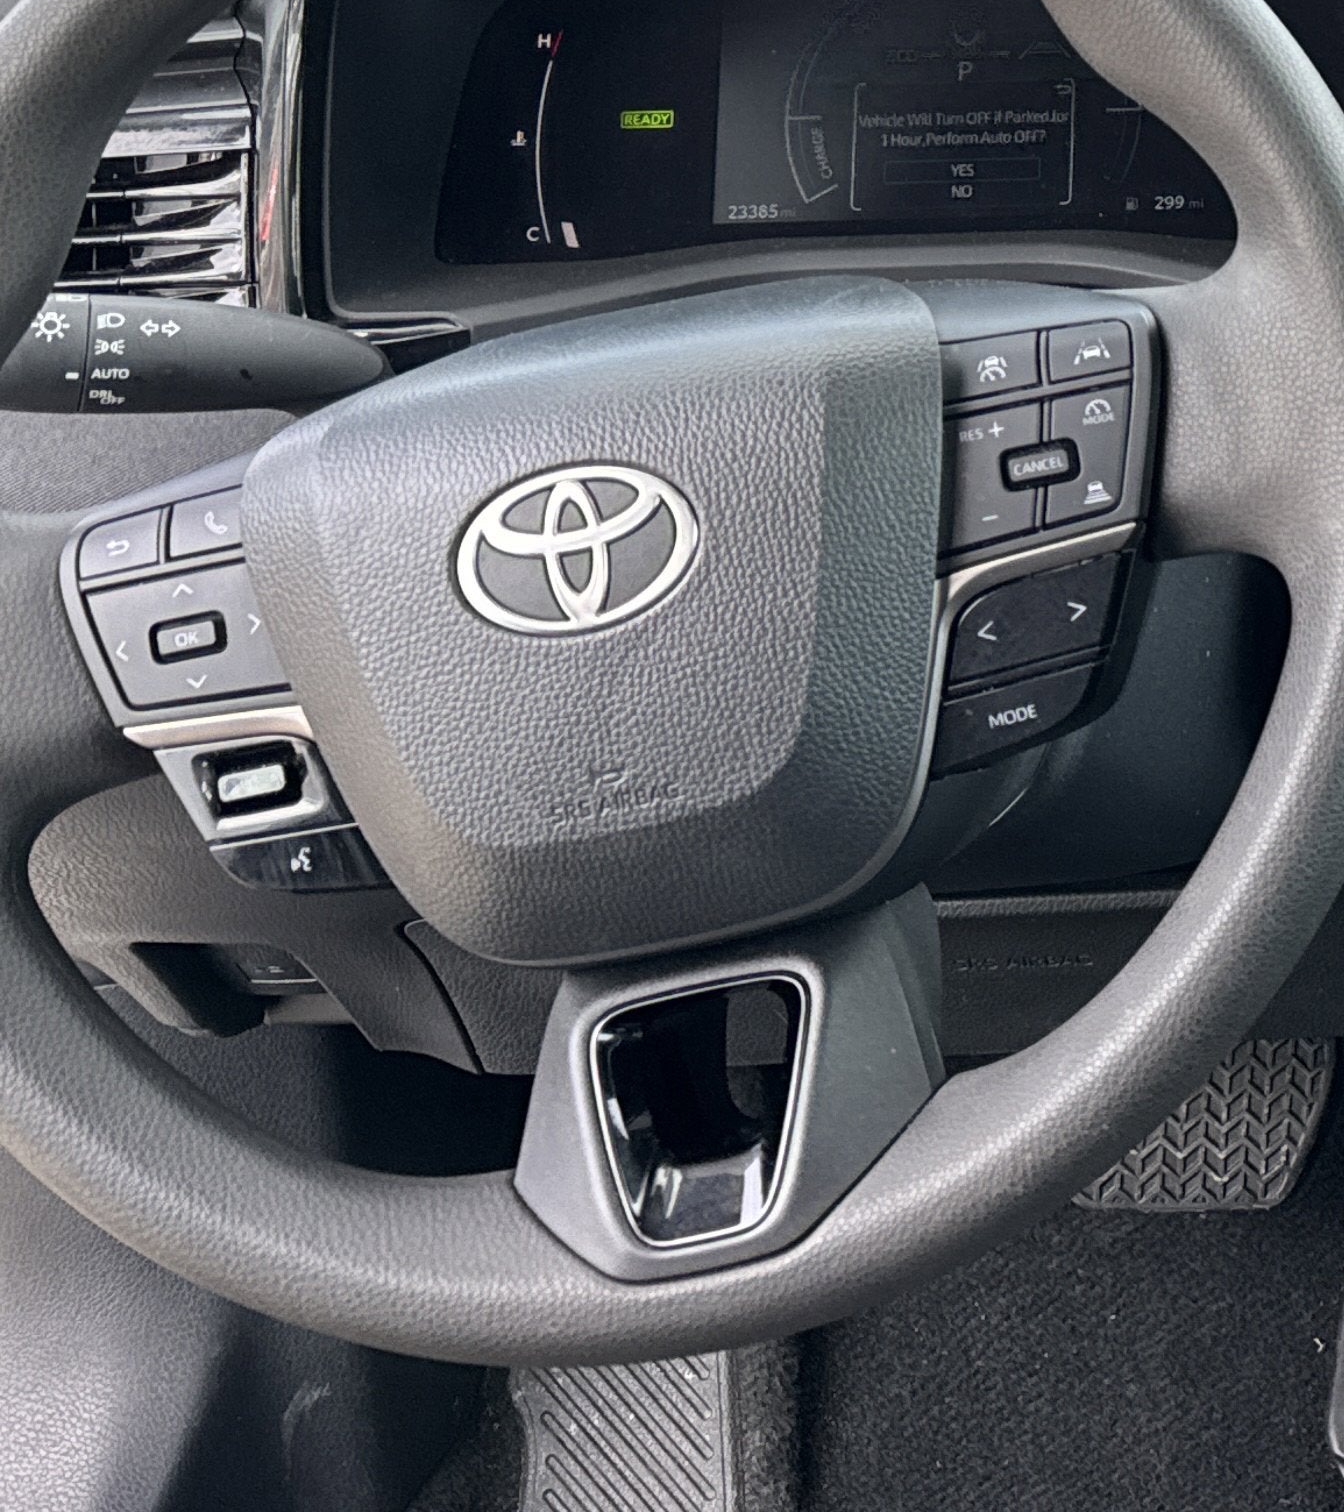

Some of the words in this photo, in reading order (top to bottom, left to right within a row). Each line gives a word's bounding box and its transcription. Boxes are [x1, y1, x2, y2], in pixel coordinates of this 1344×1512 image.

[537, 33, 552, 48] H
[958, 61, 973, 81] P
[624, 113, 670, 127] READY
[859, 113, 906, 128] Vehicle
[936, 112, 965, 126] Turn
[1004, 109, 1049, 123] Parked
[951, 163, 975, 177] YES
[951, 184, 973, 199] NO
[1154, 194, 1185, 211] 299
[1188, 198, 1205, 210] mi
[526, 226, 540, 242] C
[90, 367, 130, 380] AUTO
[1082, 411, 1115, 426] MODE
[959, 428, 984, 443] RES
[1013, 455, 1064, 476] CANCEL
[174, 630, 199, 648] OK
[988, 703, 1038, 730] MODE
